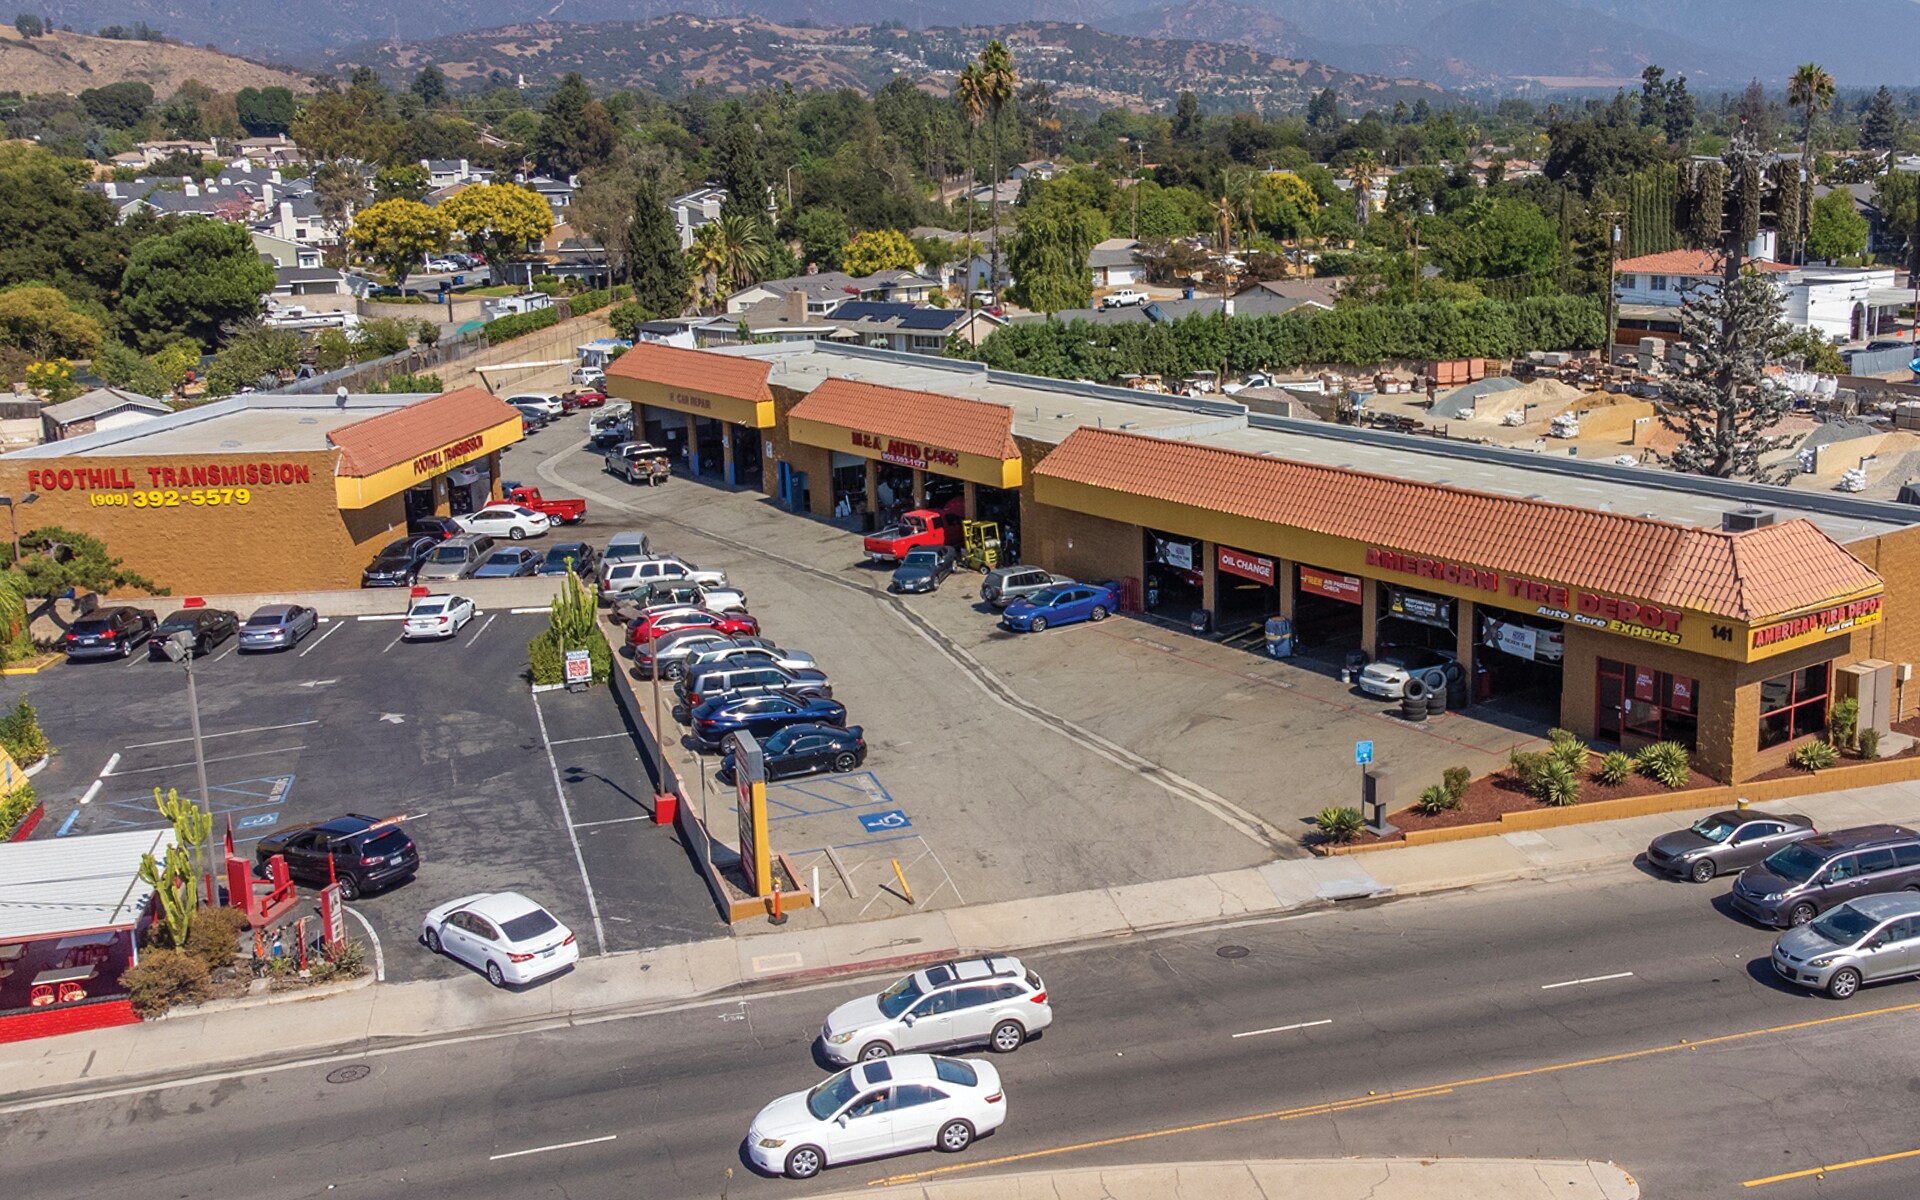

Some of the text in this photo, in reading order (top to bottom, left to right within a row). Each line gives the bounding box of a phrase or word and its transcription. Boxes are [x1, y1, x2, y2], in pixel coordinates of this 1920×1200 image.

[413, 451, 443, 476] FOOTHILL
[443, 434, 484, 462] TRANSMISSION
[851, 431, 959, 468] M&A AUTO CARE
[28, 463, 310, 491] FOOTHILL TRANSMISSION
[90, 488, 250, 508] (909) 392-5579
[1222, 554, 1236, 567] OIL
[1236, 559, 1271, 577] CHANGE
[1304, 575, 1323, 587] FREE
[1365, 548, 1684, 632] AMERICAN TIRE DEPOT
[1536, 606, 1682, 646] Auto Care Experts
[1710, 623, 1733, 643] 141
[1754, 597, 1882, 648] AMERICAN TIRE DEPOT
